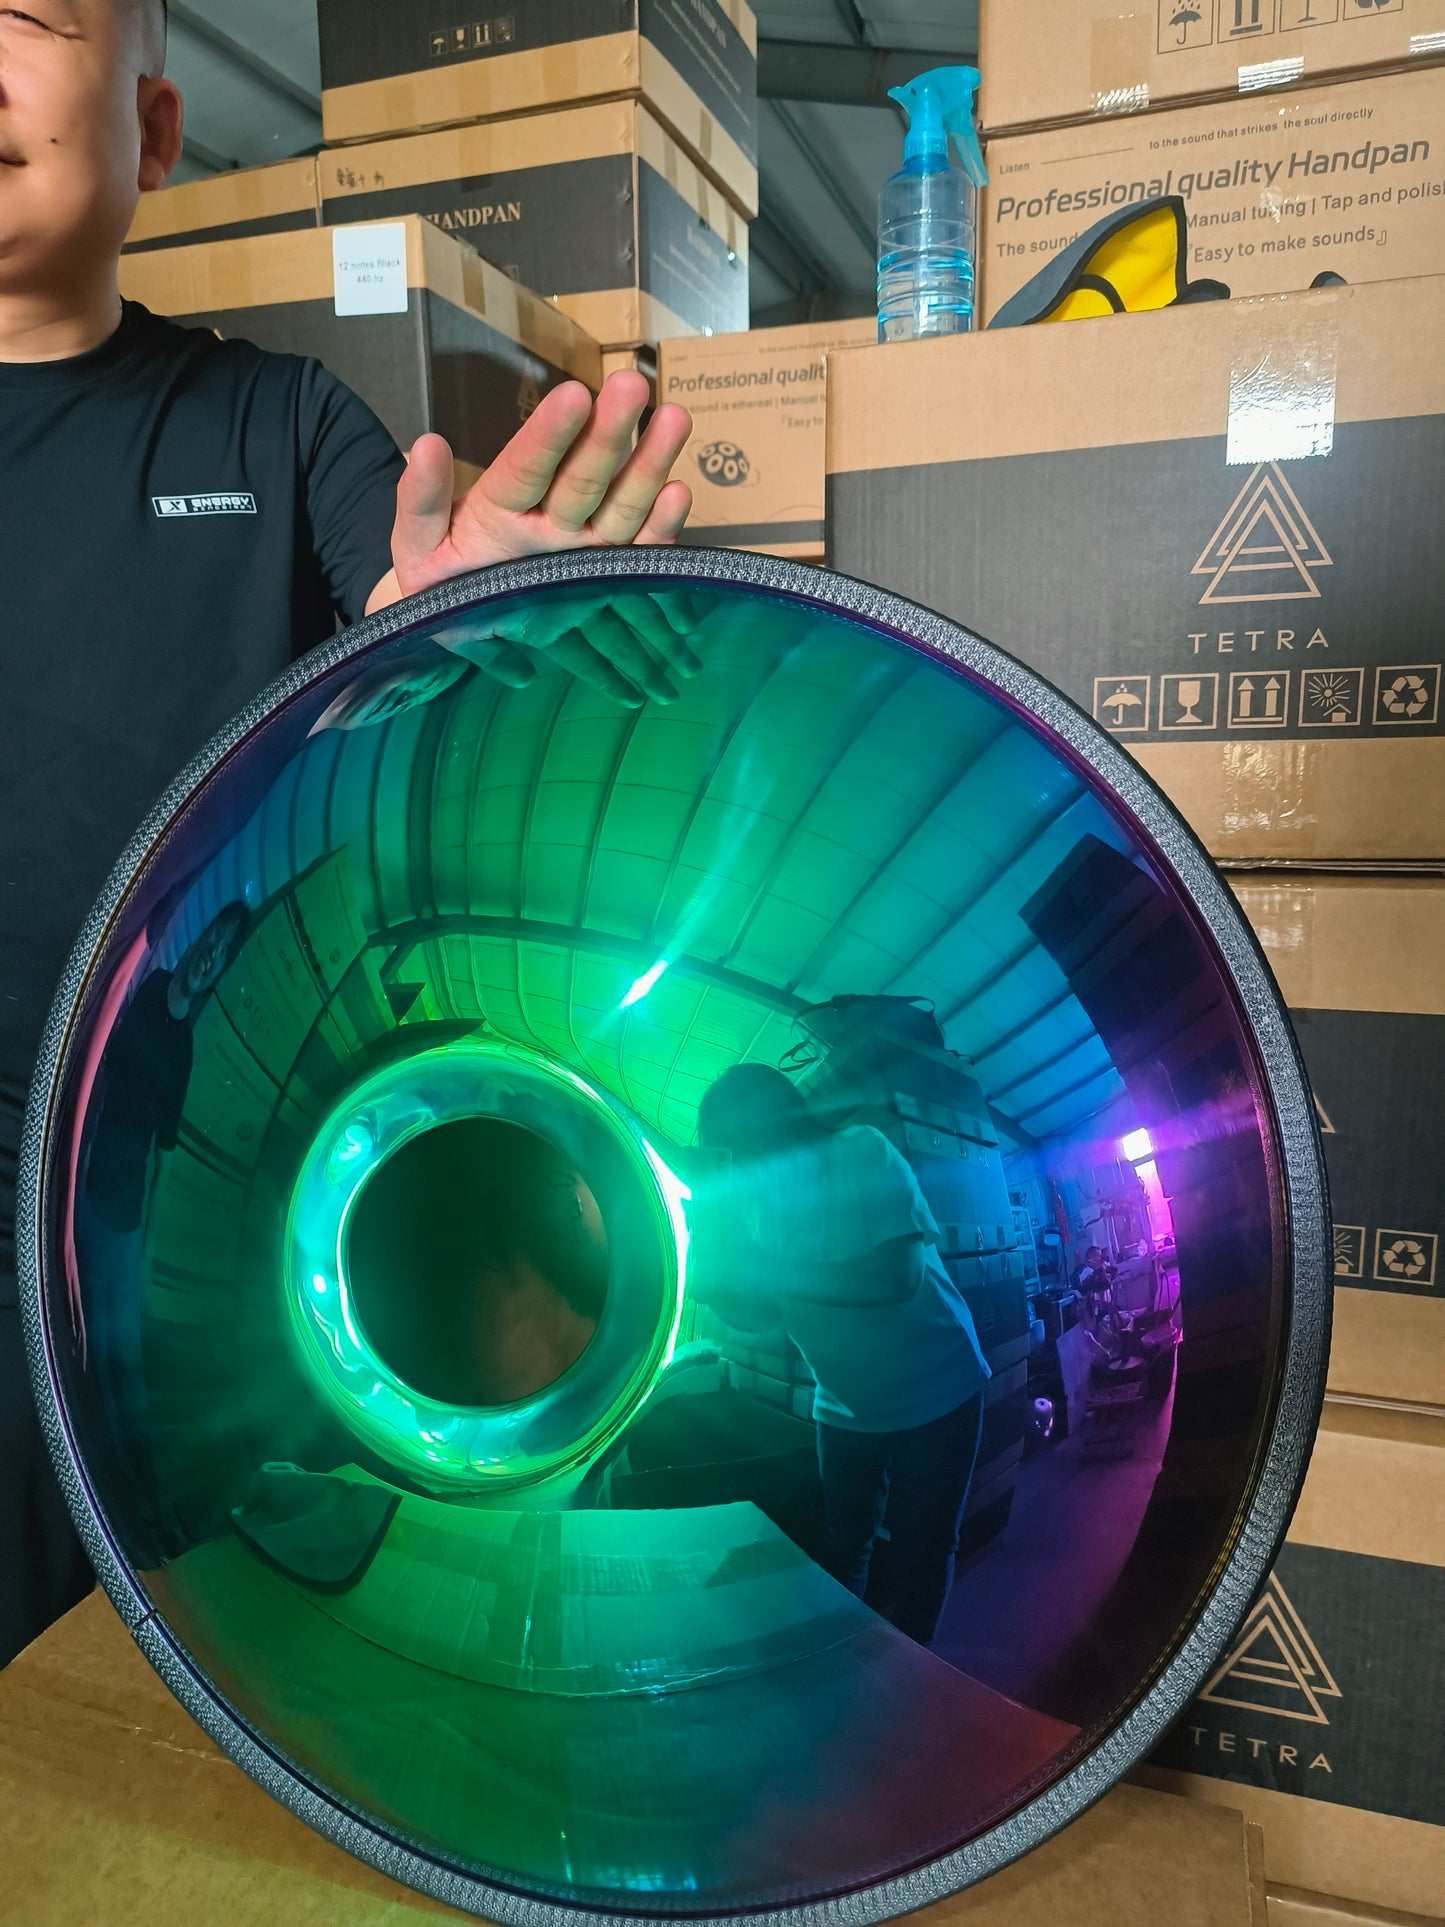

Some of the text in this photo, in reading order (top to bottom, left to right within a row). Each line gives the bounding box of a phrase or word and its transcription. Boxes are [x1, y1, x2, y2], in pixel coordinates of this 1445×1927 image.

[999, 107, 1374, 175] Listen to the sound that strikes the soul directly
[996, 139, 1430, 223] Professional quality Handpan
[996, 242, 1025, 258] The
[1029, 232, 1079, 253] sound
[1187, 206, 1247, 229] Manual
[1322, 194, 1353, 212] Tap
[1358, 187, 1393, 206] and
[1397, 180, 1445, 205] polis
[1238, 243, 1255, 257] to
[1261, 234, 1306, 254] make
[668, 367, 773, 393] Professional
[190, 496, 250, 508] ENERGY
[1187, 627, 1330, 655] TETRA
[1188, 1726, 1334, 1774] TETRA
